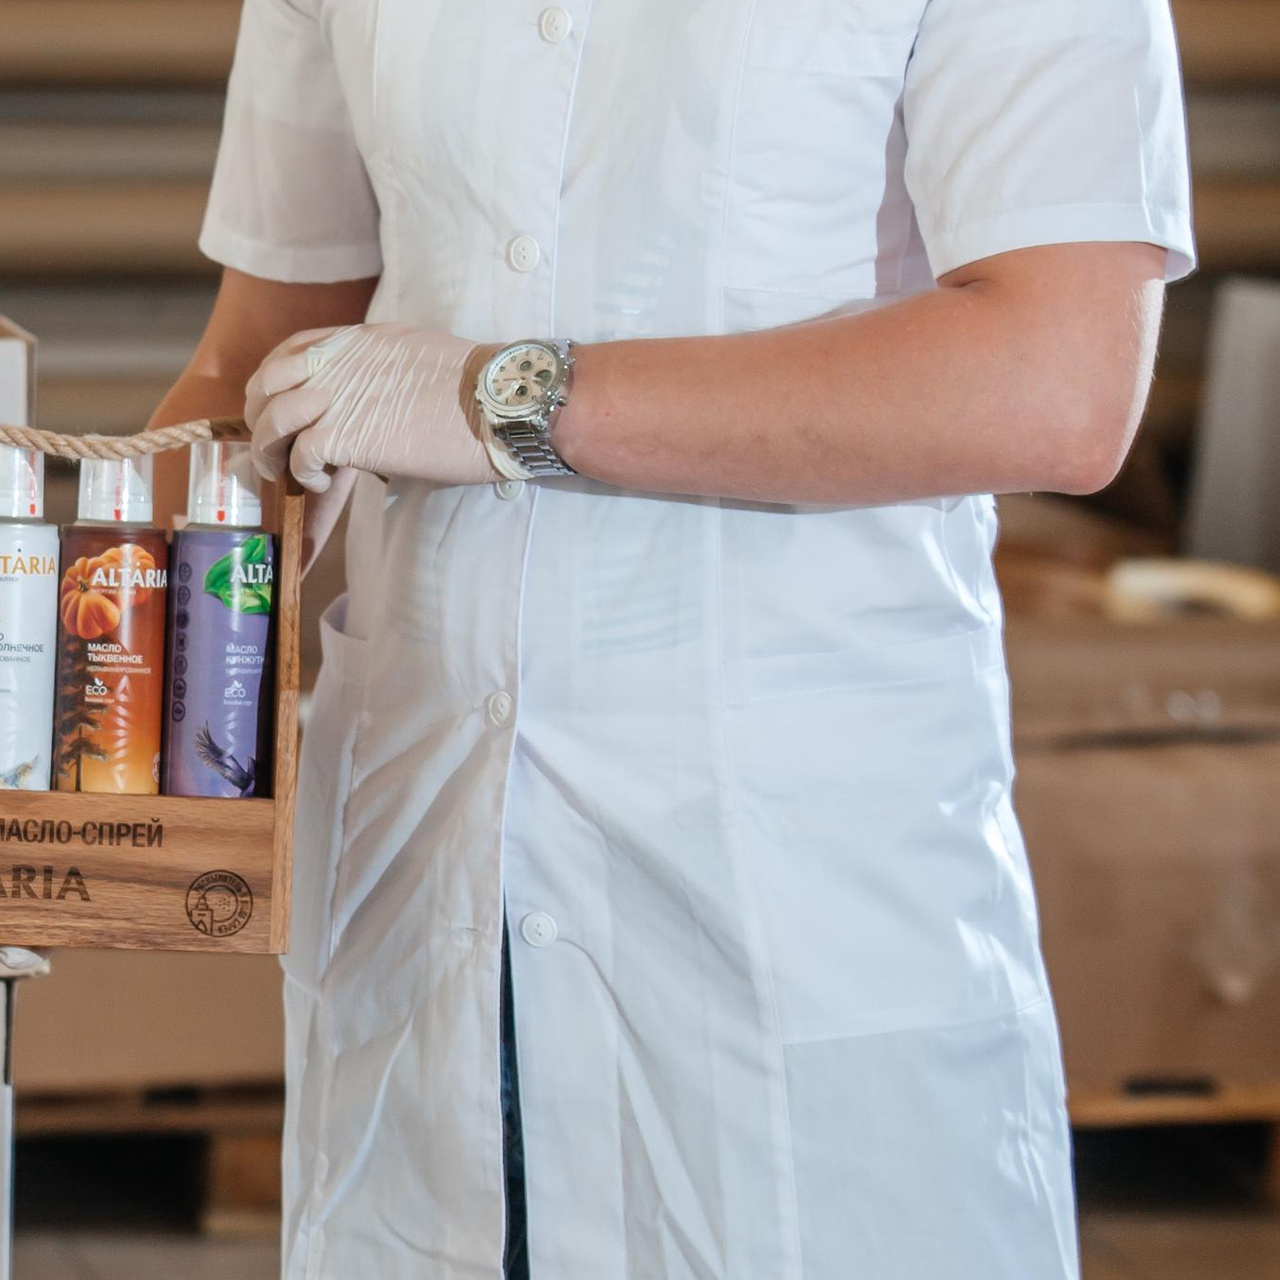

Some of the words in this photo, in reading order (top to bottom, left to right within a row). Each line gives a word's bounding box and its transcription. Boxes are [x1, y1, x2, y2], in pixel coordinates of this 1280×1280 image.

[91, 567, 168, 588] ALTARIA
[231, 564, 273, 584] ALTA
[88, 643, 122, 653] МАСЛО
[87, 653, 143, 664] ТЫКВЕННОЕ
[85, 684, 108, 696] ECO
[224, 687, 247, 698] ECO
